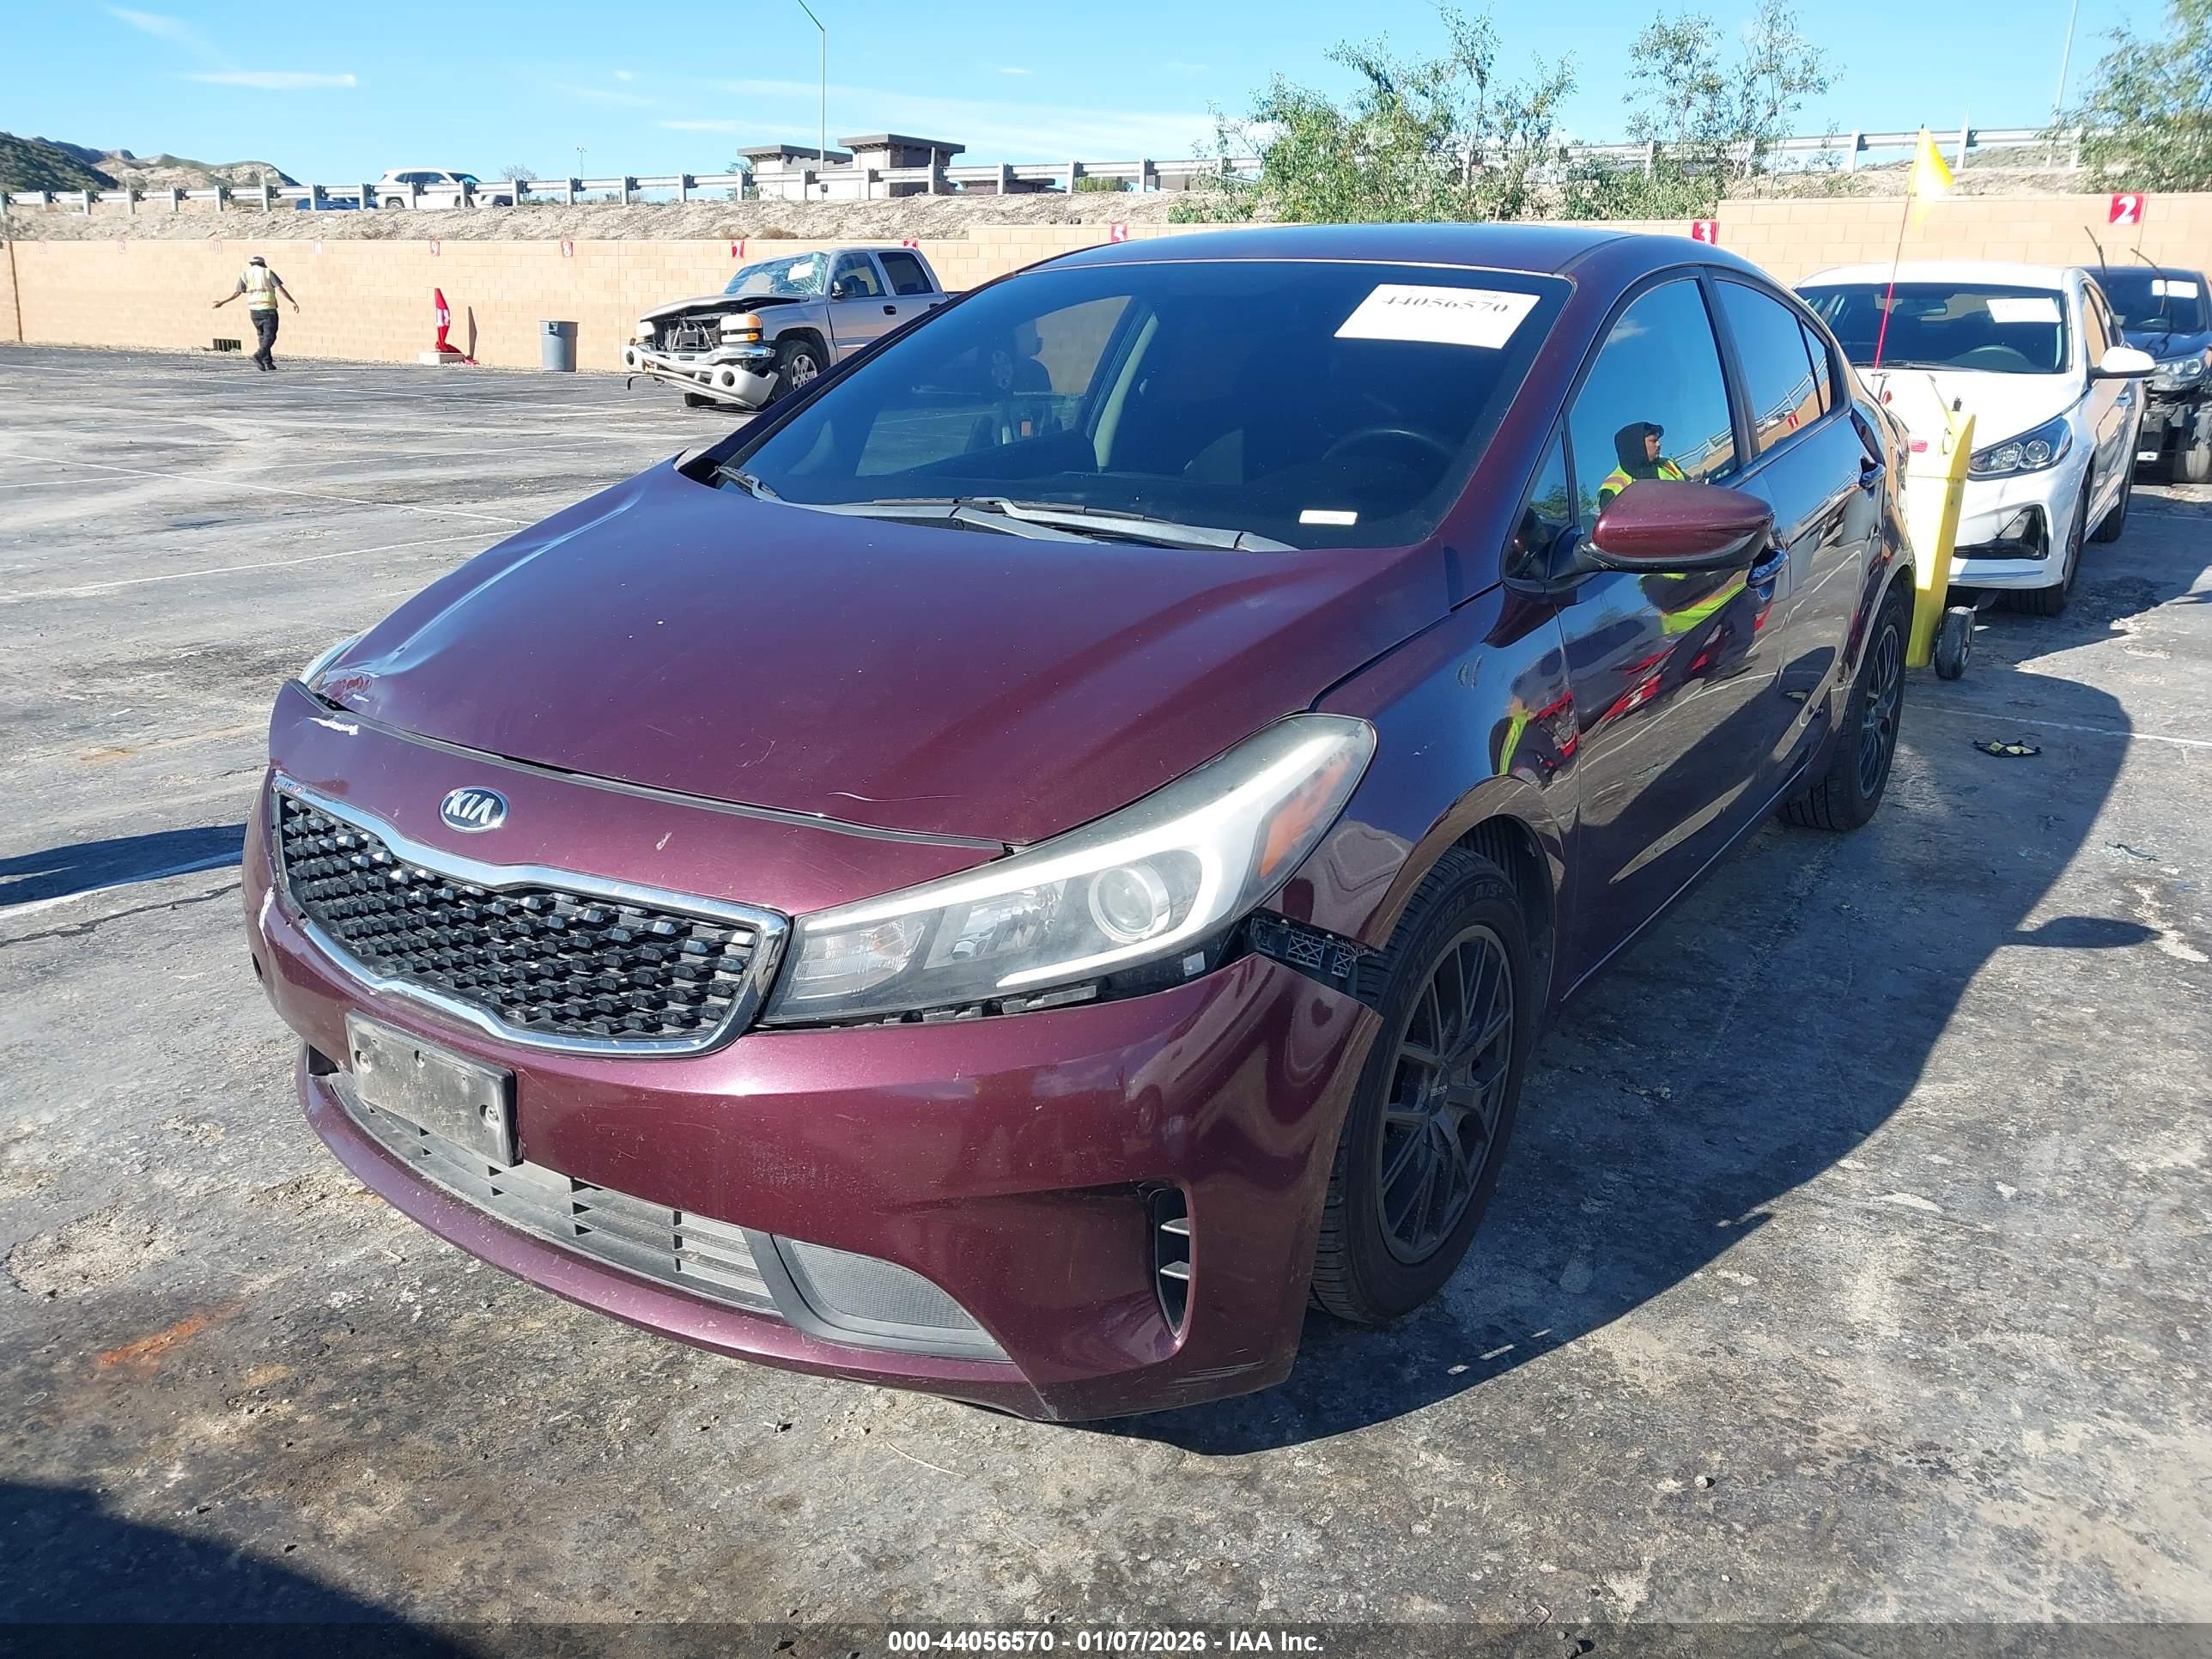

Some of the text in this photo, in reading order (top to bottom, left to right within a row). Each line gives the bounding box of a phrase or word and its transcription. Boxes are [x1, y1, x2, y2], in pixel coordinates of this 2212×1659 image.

[2115, 196, 2137, 224] 2
[562, 240, 571, 258] 8
[1382, 296, 1509, 313] 44056570
[445, 791, 495, 824] KIA
